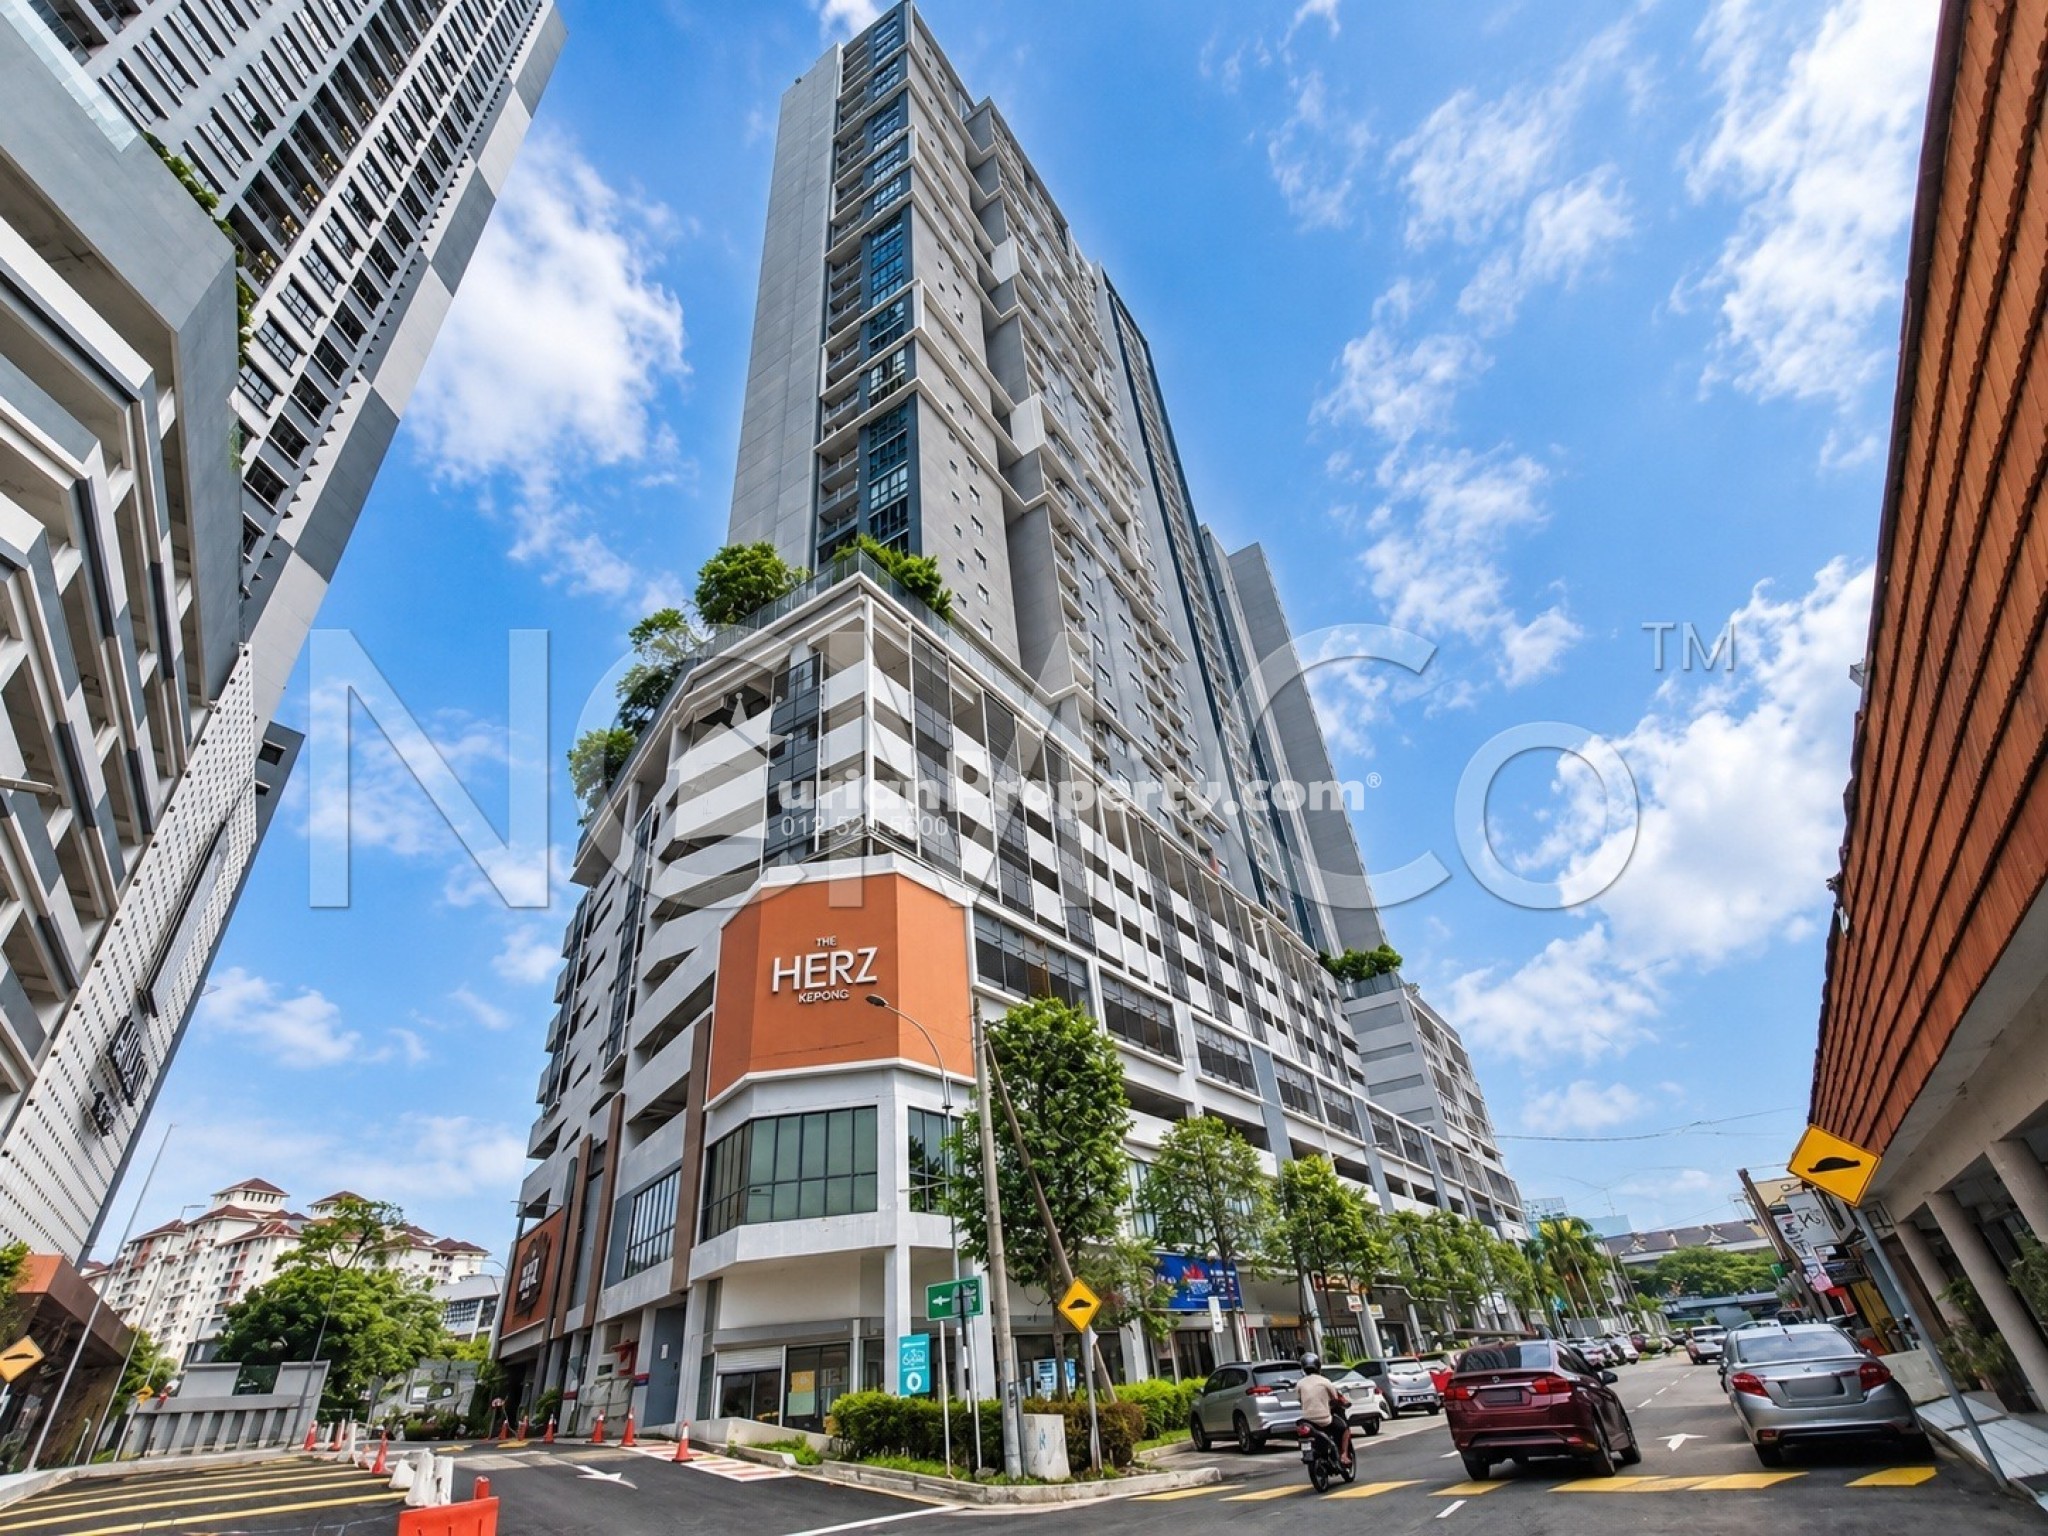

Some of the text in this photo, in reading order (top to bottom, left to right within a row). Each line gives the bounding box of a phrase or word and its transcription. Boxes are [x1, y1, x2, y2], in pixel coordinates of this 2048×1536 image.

[816, 935, 837, 947] THE
[772, 946, 878, 992] HERZ
[798, 989, 850, 1004] KEPONG
